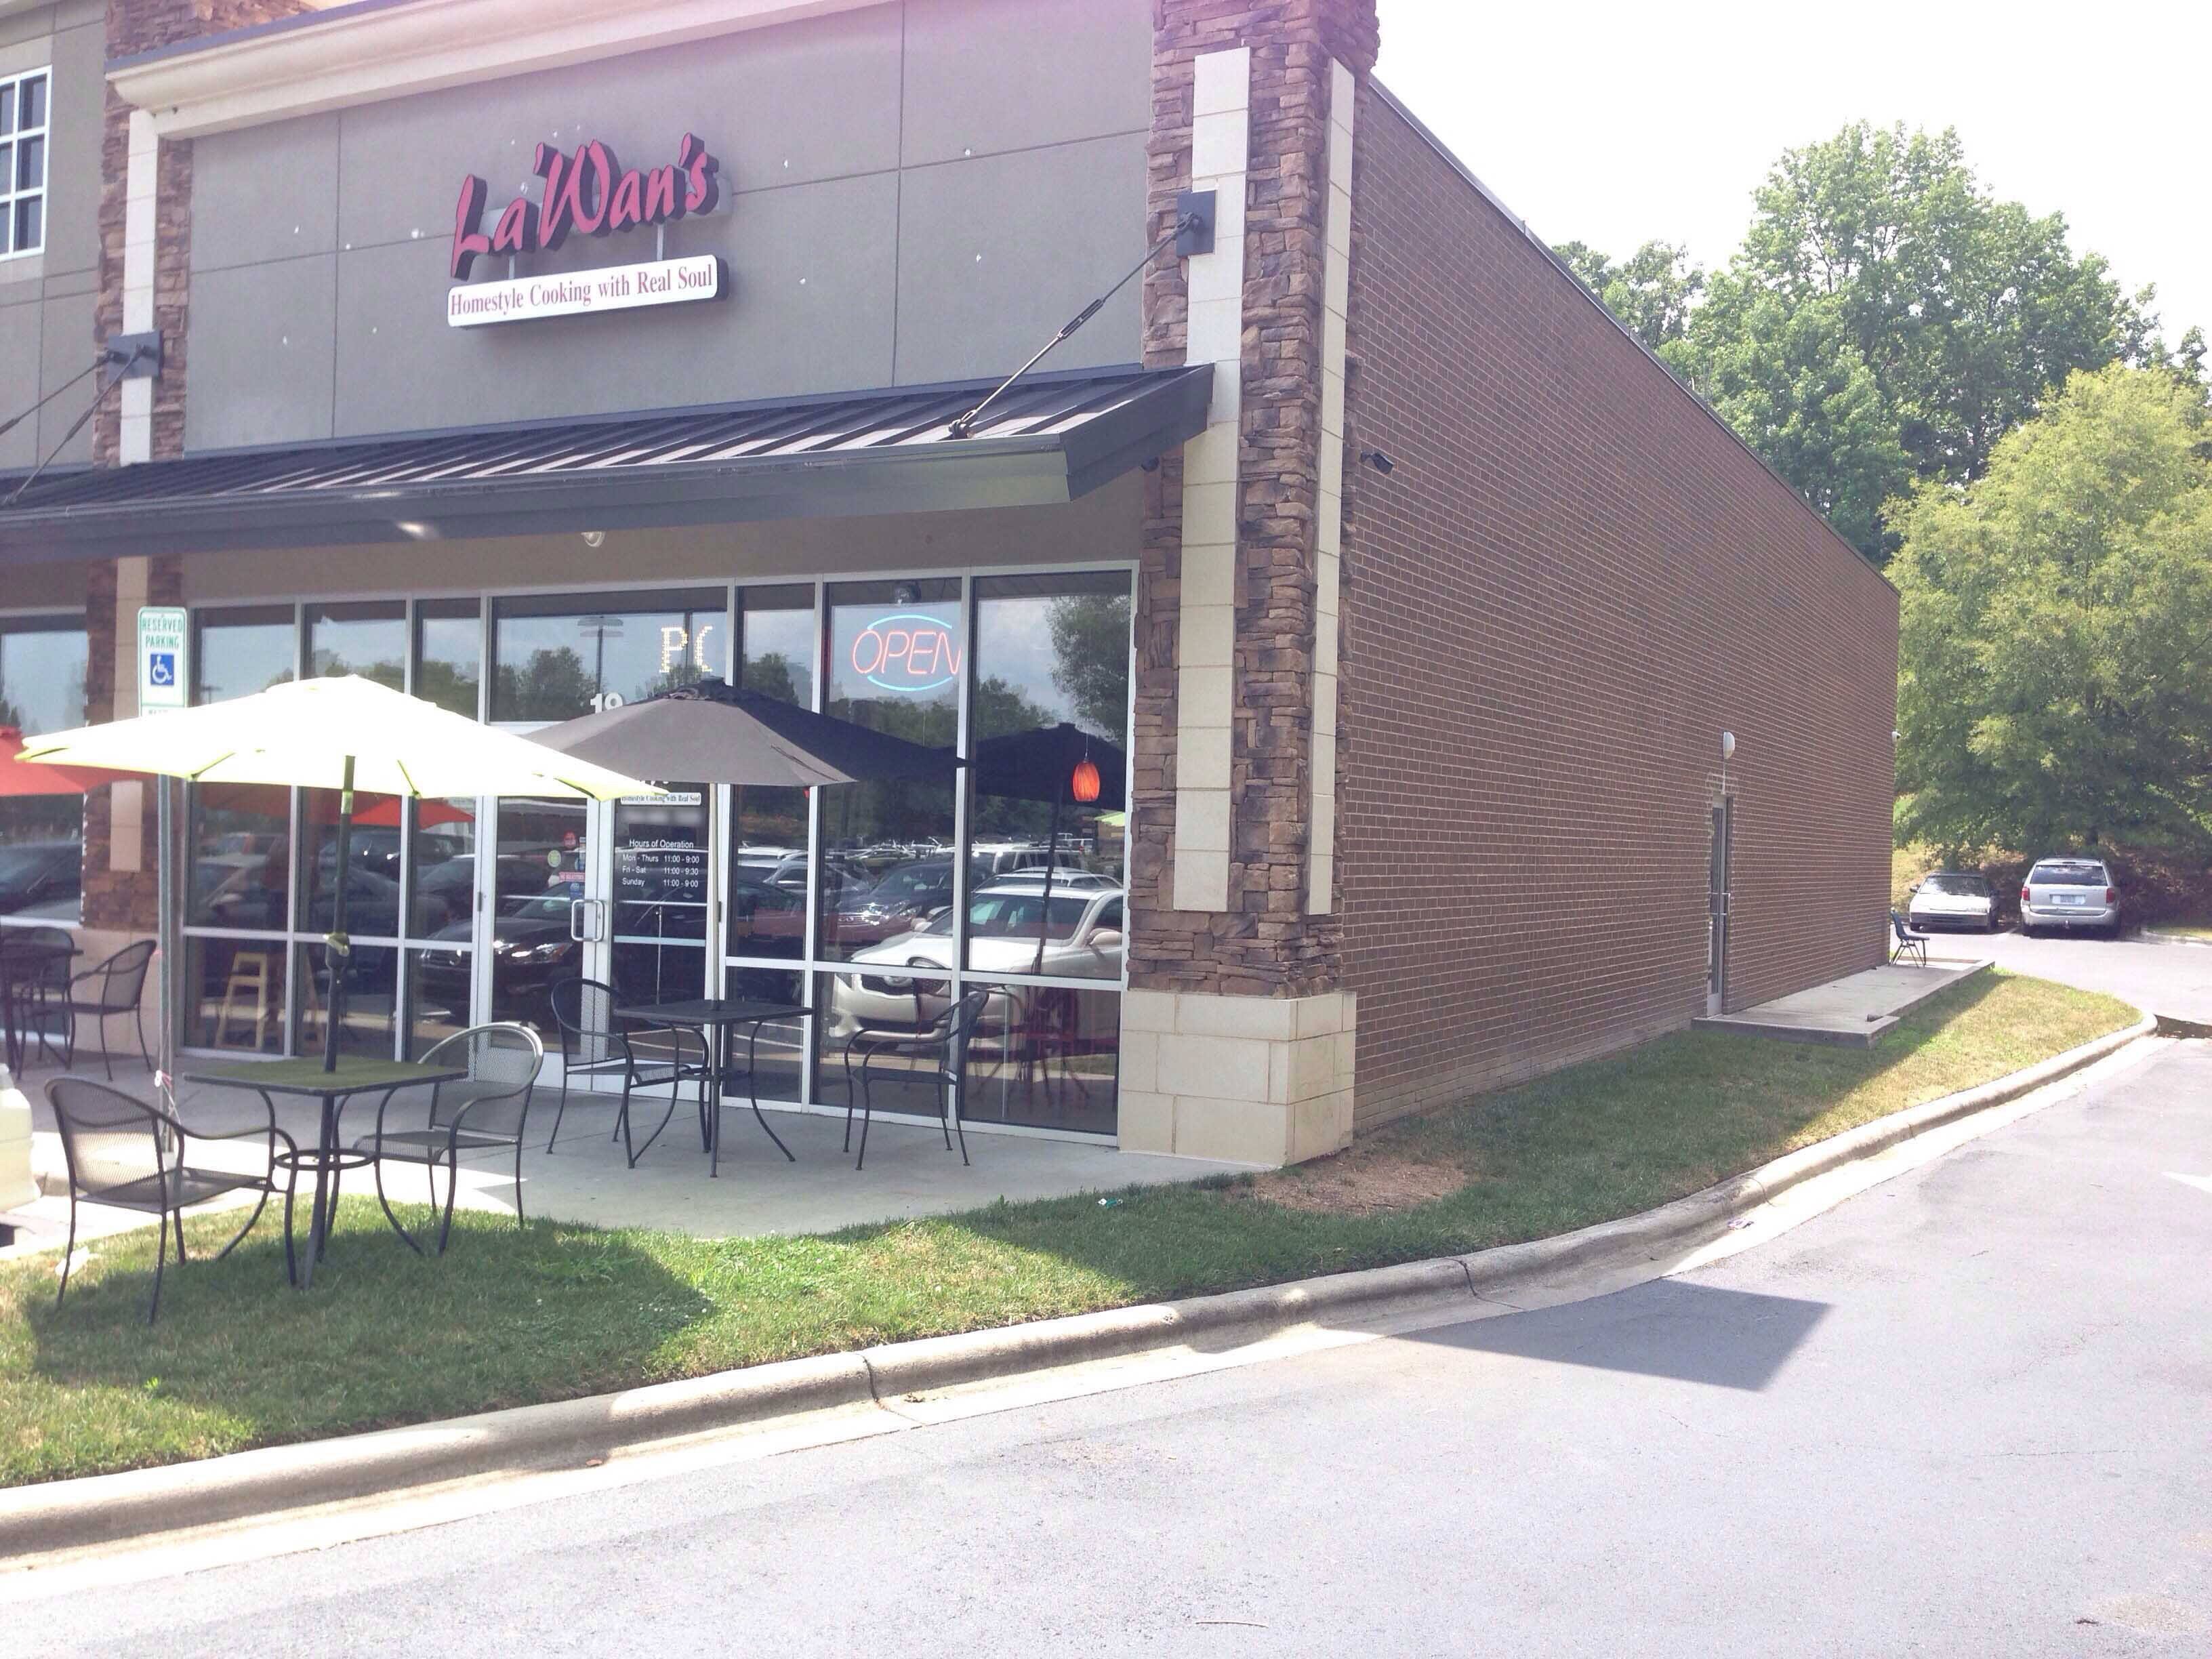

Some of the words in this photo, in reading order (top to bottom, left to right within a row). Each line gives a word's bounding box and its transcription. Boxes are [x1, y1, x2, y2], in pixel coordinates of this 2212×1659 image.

[451, 132, 714, 280] La'Wan's
[451, 287, 524, 316] Homestyle
[530, 281, 592, 307] Cooking
[598, 274, 630, 298] with
[637, 269, 671, 295] Real
[678, 264, 712, 290] Soul
[141, 617, 183, 632] RESERVED
[145, 634, 180, 649] PARKING
[852, 629, 962, 675] OPEN
[629, 839, 650, 848] Hours
[651, 839, 659, 848] of
[659, 840, 695, 848] Operation
[685, 855, 699, 863] 9:00
[622, 878, 645, 887] Sunday
[663, 879, 680, 887] 11:00
[684, 880, 699, 888] 9:00
